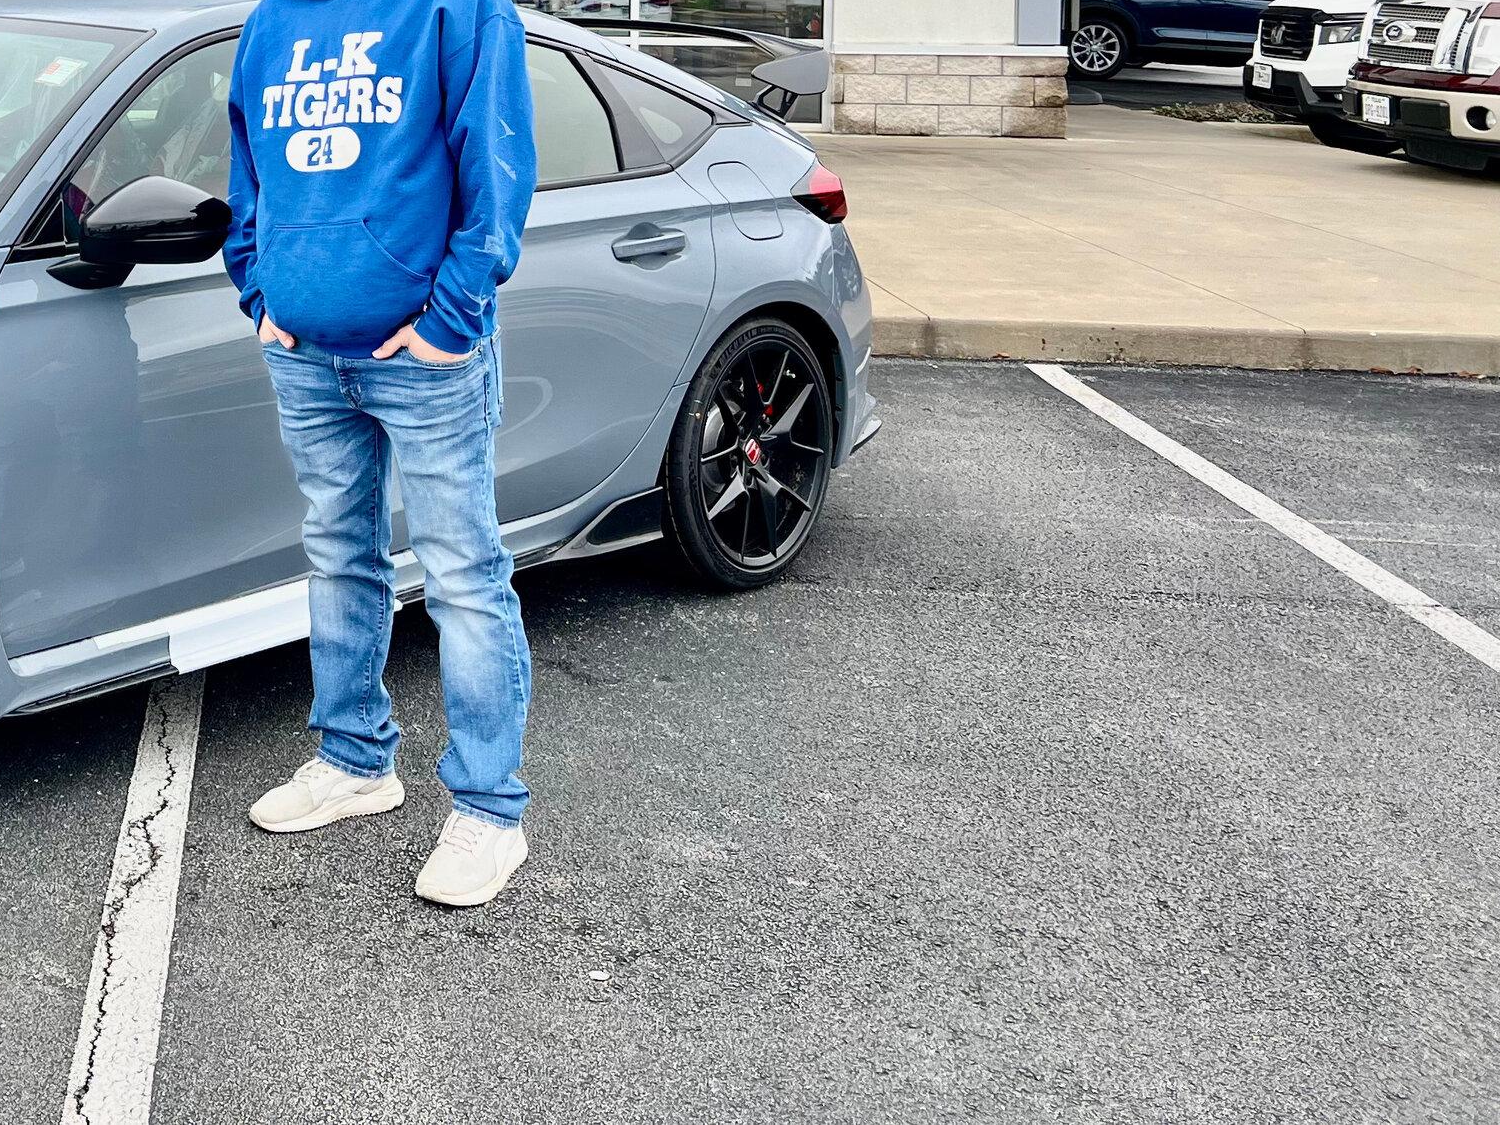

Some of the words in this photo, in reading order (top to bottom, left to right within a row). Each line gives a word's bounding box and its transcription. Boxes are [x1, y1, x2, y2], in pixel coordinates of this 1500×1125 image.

[284, 31, 383, 83] L-K
[262, 76, 403, 130] TIGERS
[306, 134, 333, 167] 24
